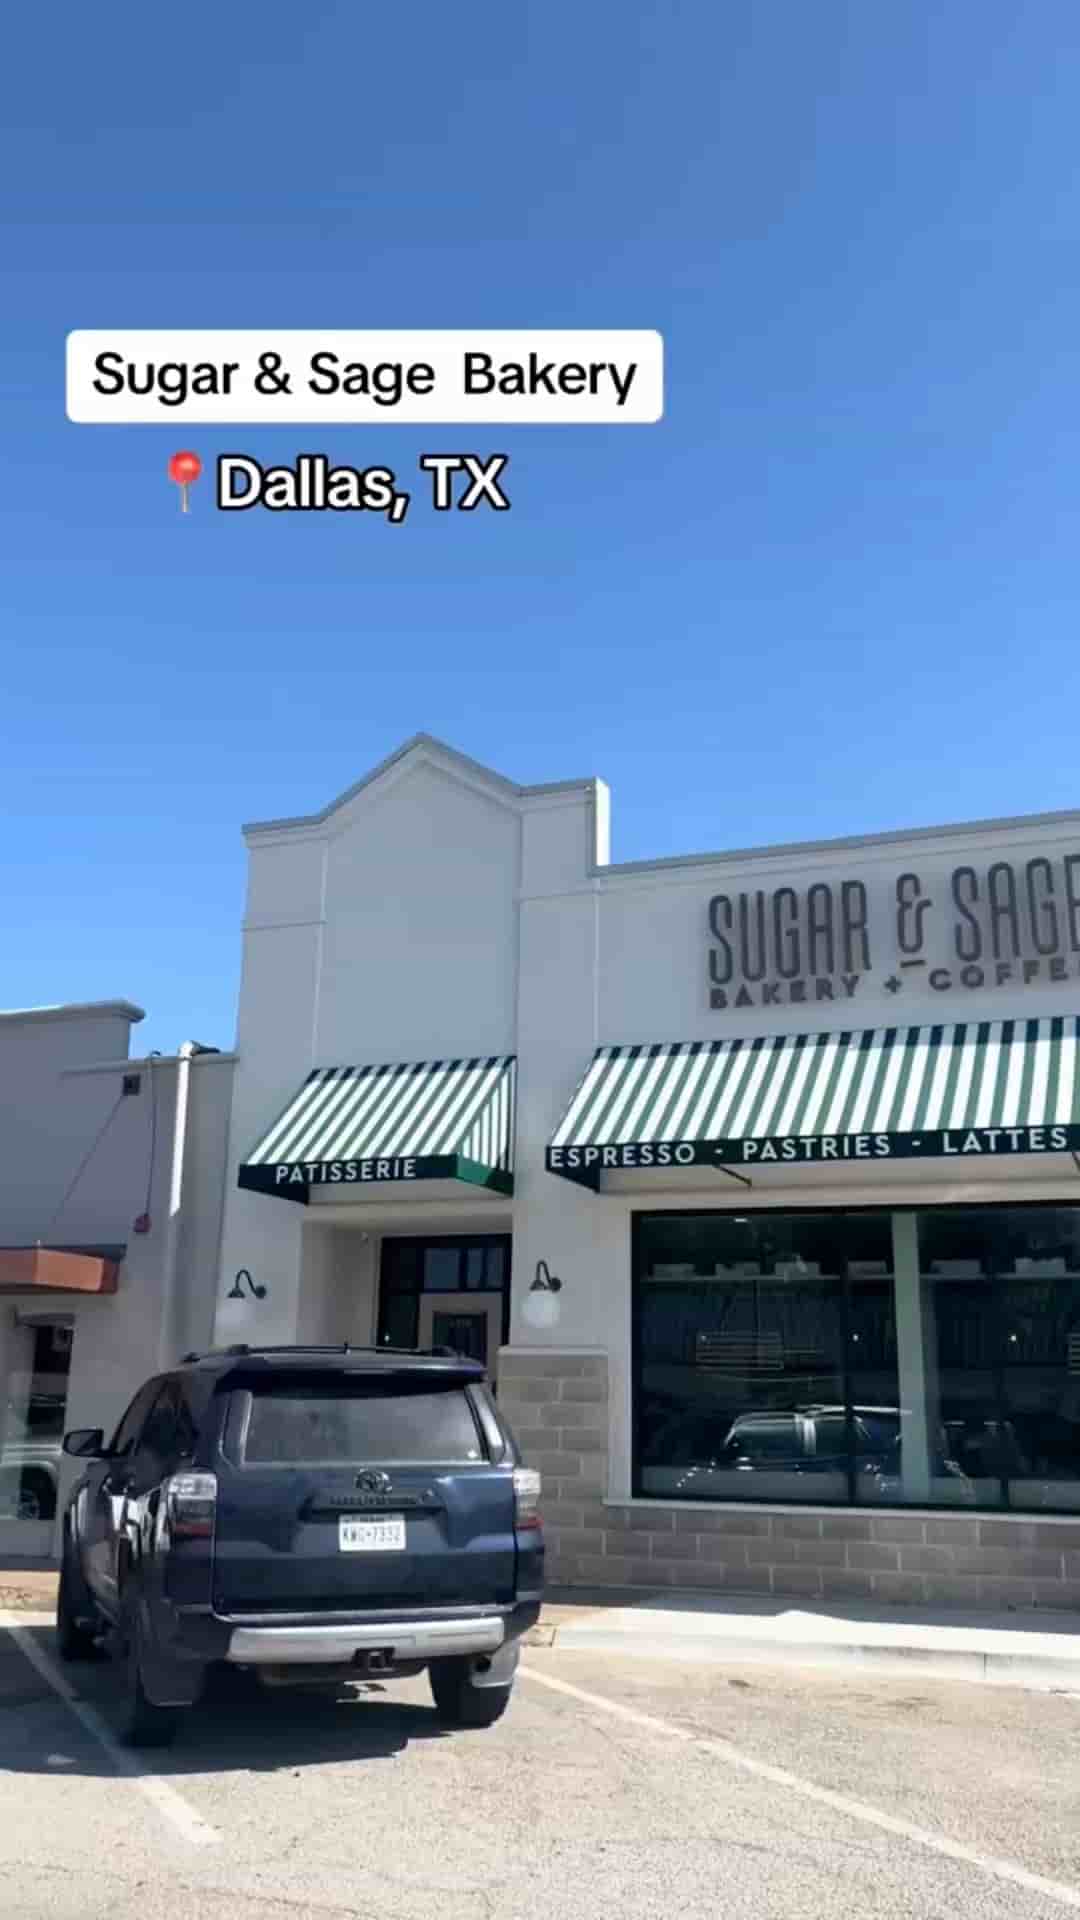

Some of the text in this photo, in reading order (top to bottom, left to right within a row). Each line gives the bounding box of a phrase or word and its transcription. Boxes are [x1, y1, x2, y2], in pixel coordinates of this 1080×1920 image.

[708, 855, 1080, 985] SUGAR & SAGE
[710, 975, 860, 1010] BAKERY
[928, 956, 1080, 992] COFFE
[550, 1142, 695, 1168] ESPRESSO
[742, 1134, 892, 1161] PASTRIES
[943, 1126, 1068, 1153] LATTES
[275, 1158, 417, 1185] PATISSERIE
